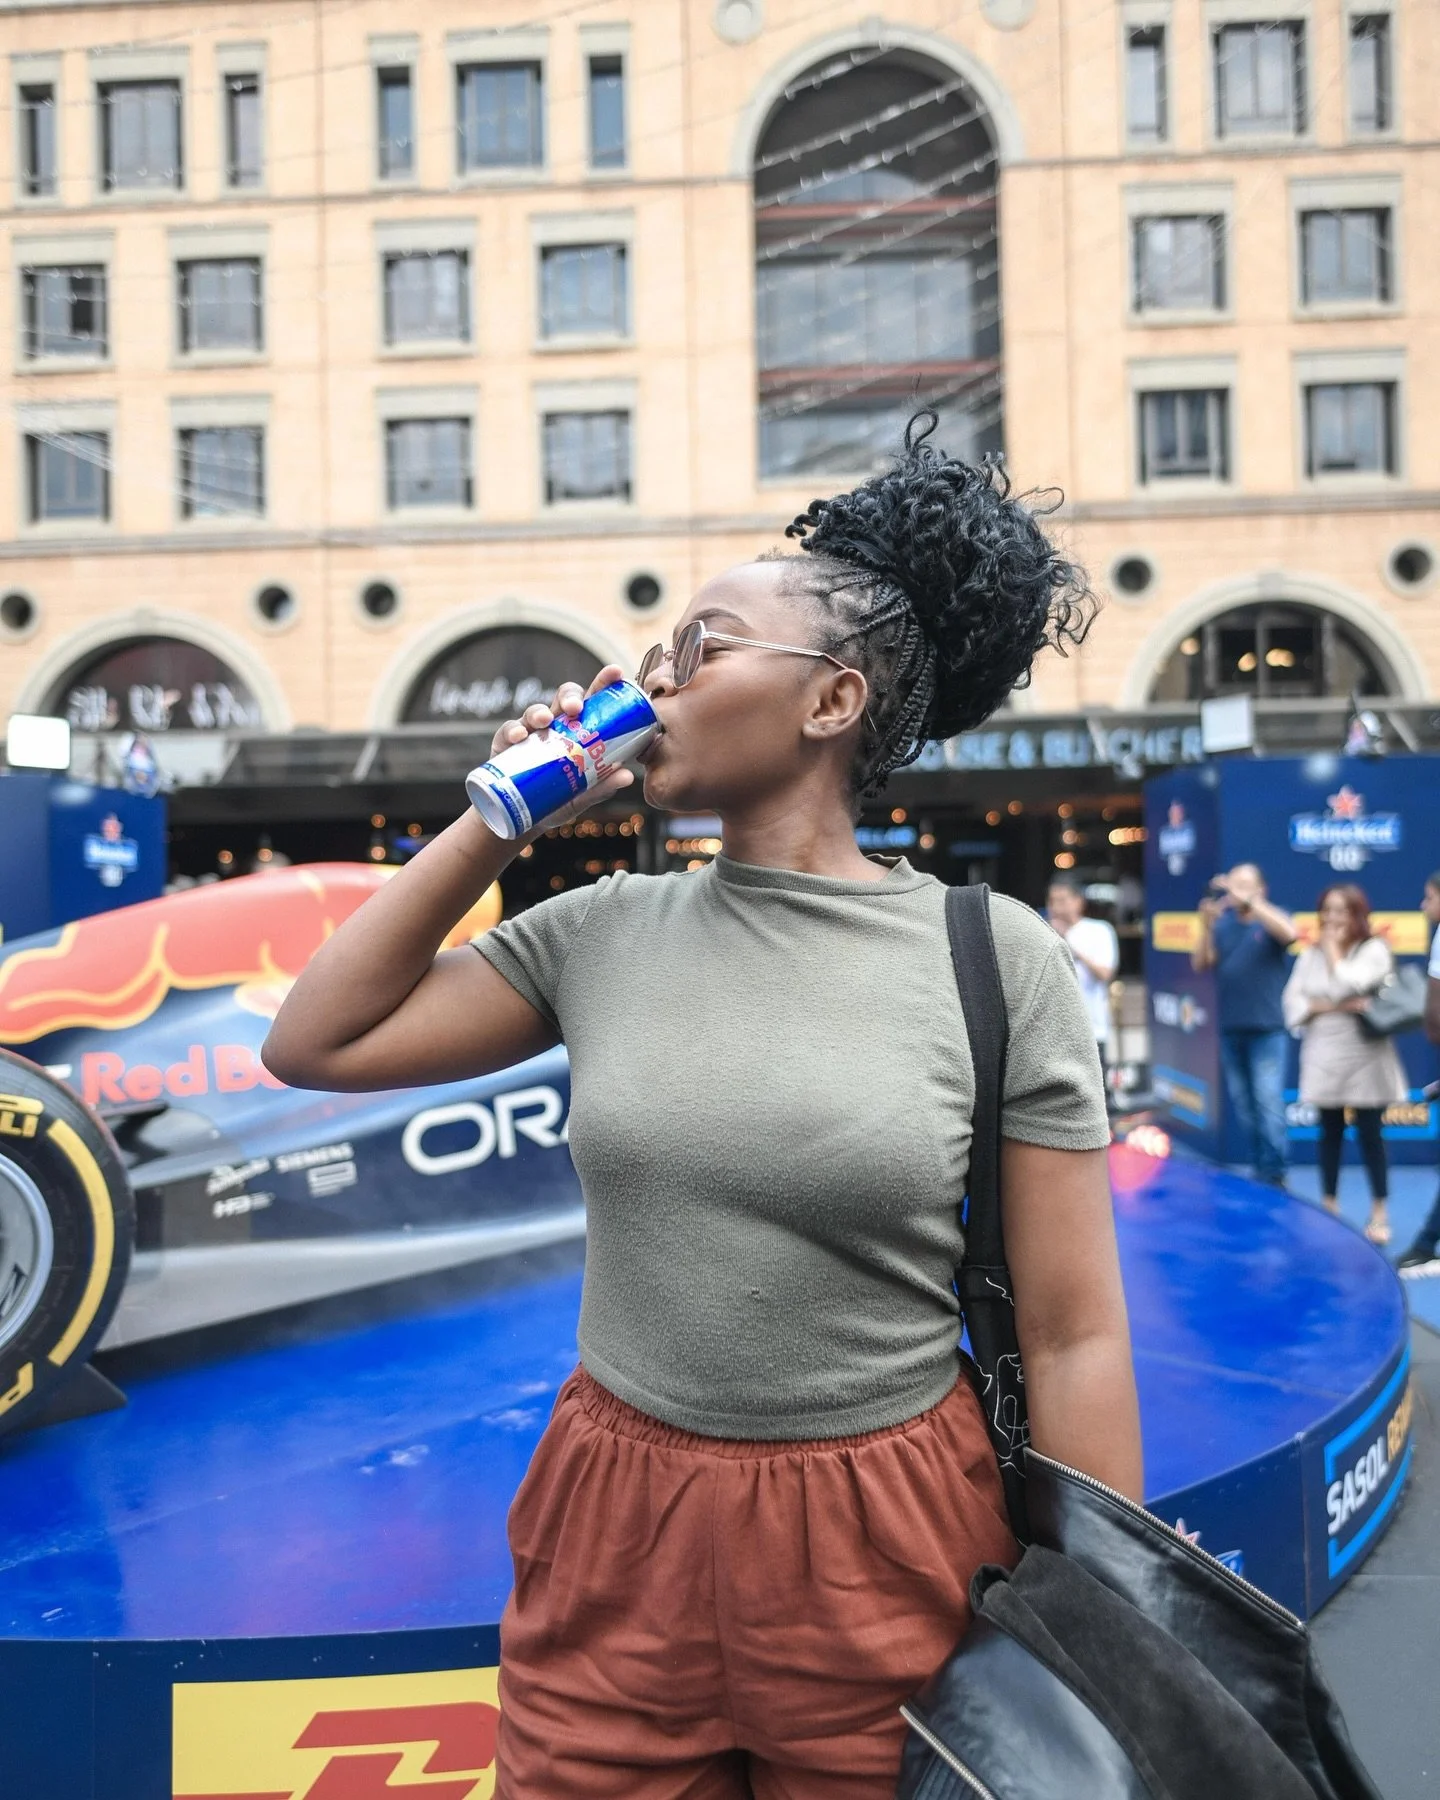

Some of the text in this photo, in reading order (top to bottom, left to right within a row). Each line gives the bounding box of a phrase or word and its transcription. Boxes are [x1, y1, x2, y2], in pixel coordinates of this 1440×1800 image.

[81, 1046, 208, 1106] Red
[402, 1086, 568, 1176] OR
[1327, 1434, 1389, 1536] SASOL
